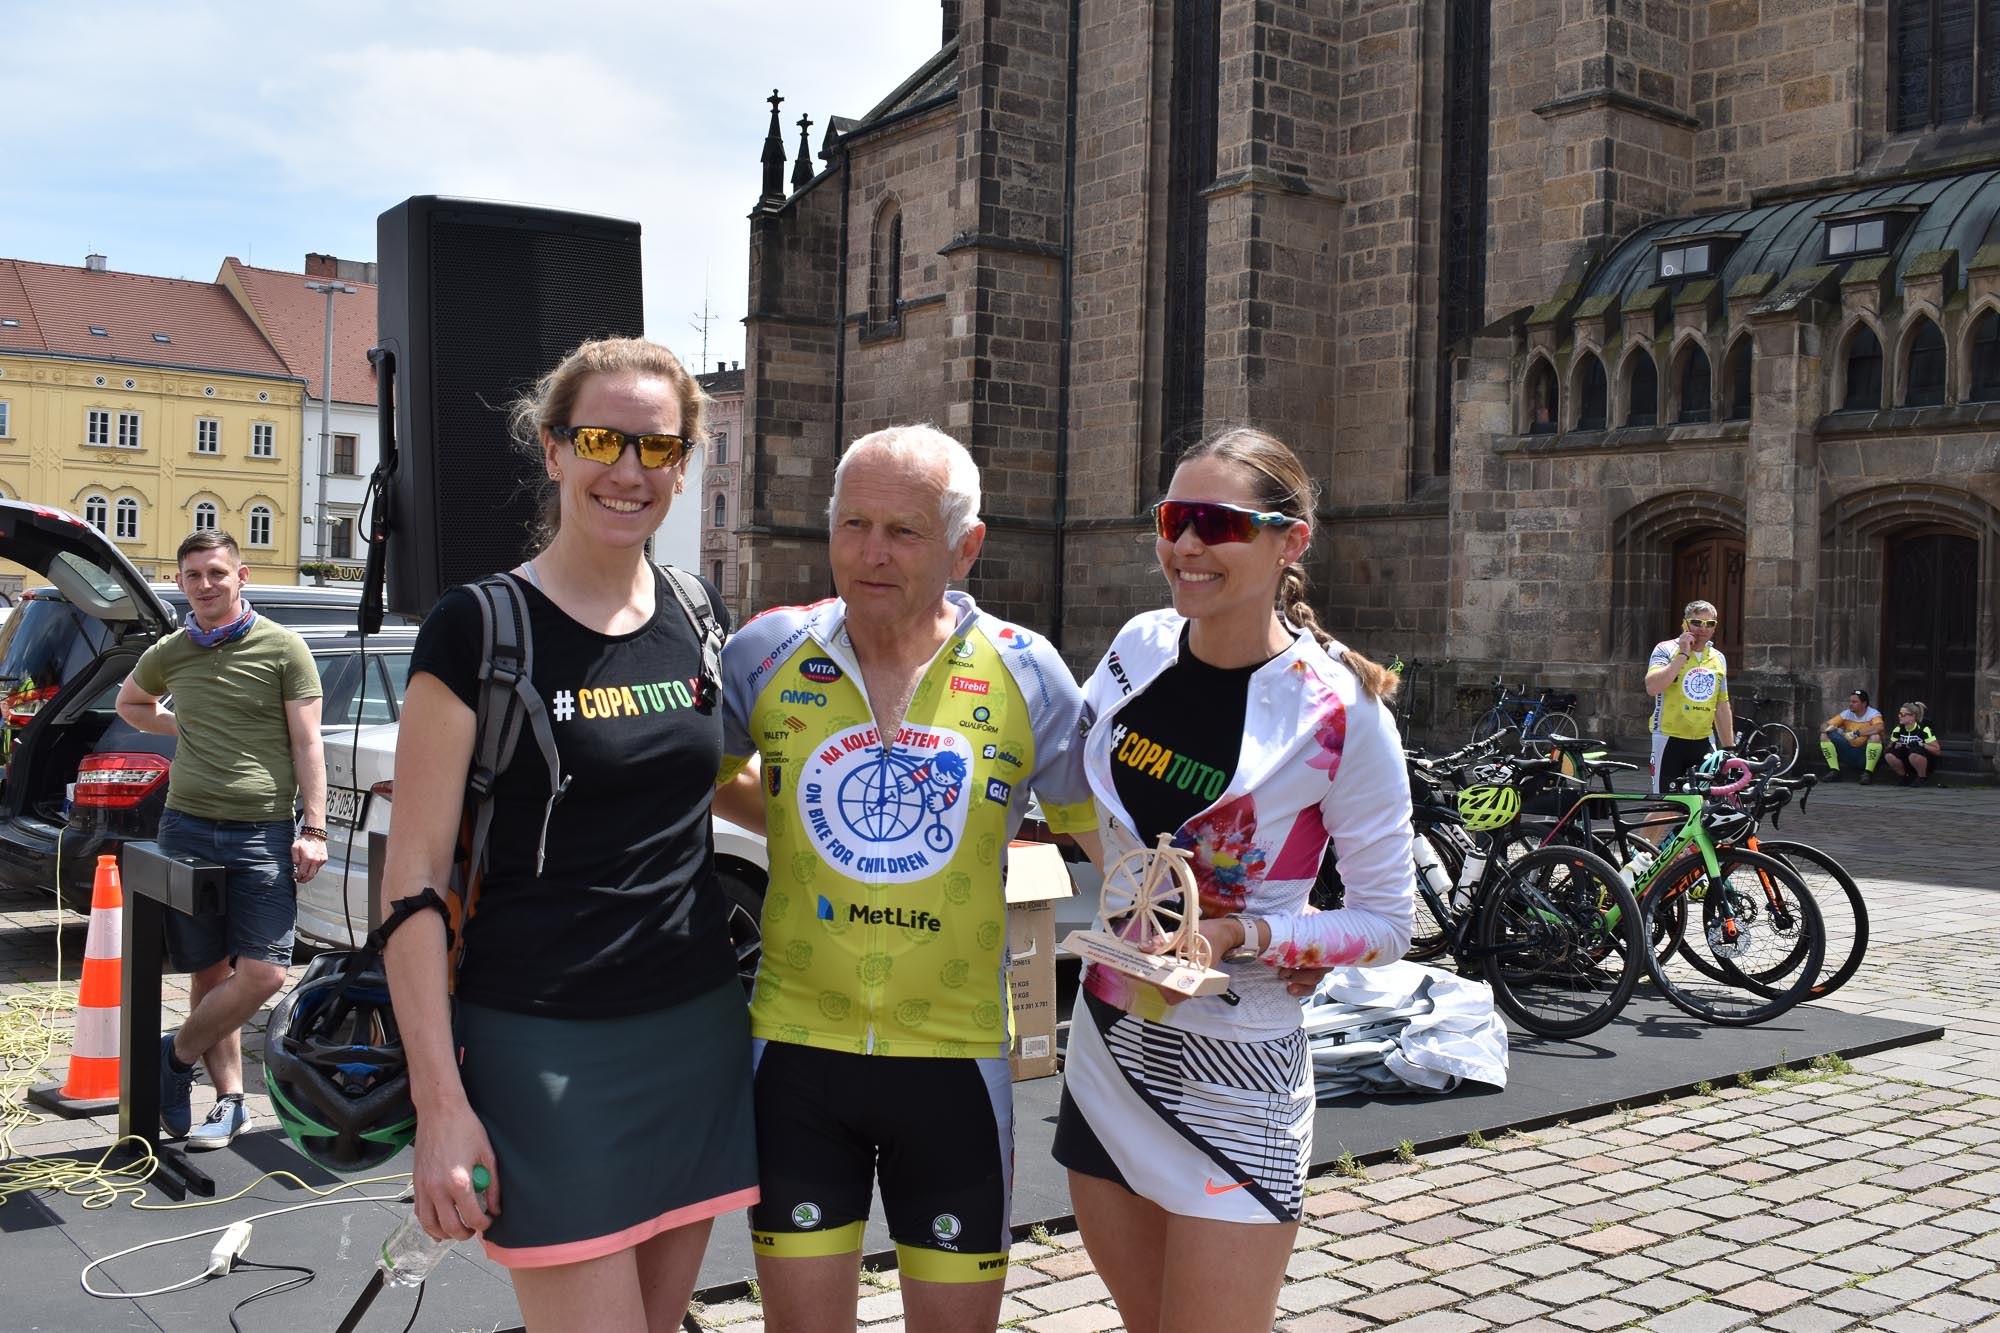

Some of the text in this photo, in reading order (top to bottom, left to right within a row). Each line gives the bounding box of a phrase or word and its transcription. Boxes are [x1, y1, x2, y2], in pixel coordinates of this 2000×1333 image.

[808, 662, 836, 675] VITA
[959, 680, 987, 692] Třebíč
[780, 689, 827, 708] AMPO
[764, 731, 790, 740] PALETY
[959, 720, 999, 734] QUALIFORM
[820, 745, 844, 766] NA
[896, 728, 940, 750] DĚTEM
[1111, 723, 1226, 801] #COPATUTO
[989, 783, 1009, 801] GLS
[806, 783, 929, 874] ON BIKE FOR CHILDREN
[1631, 836, 1686, 895] RBEA
[849, 903, 941, 932] MetLife
